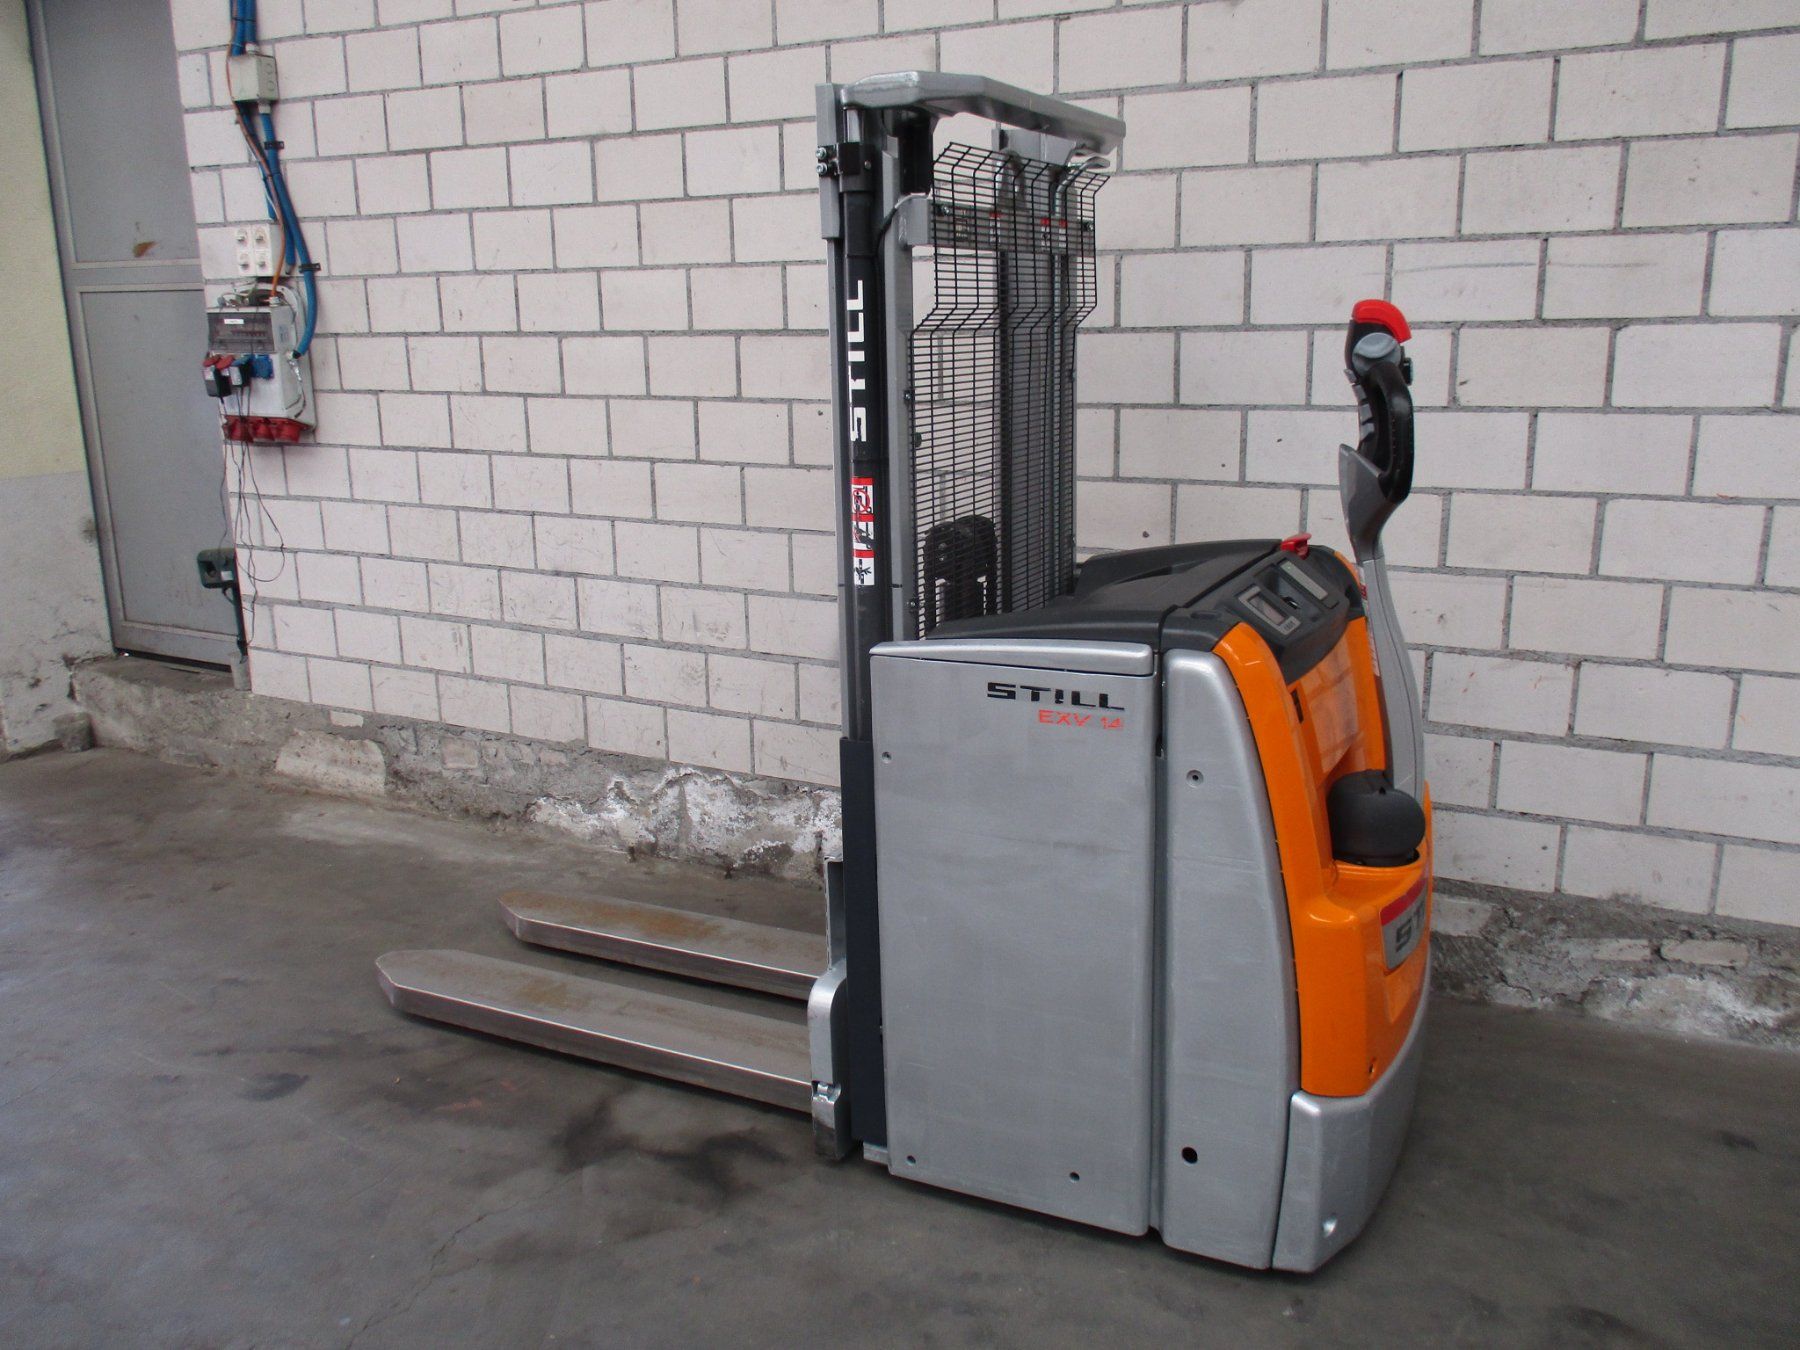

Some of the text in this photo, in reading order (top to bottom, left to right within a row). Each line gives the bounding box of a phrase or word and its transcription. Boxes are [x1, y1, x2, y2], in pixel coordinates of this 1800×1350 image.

[847, 279, 867, 442] STILL
[987, 682, 1125, 711] STILL
[1038, 709, 1122, 730] EXV 14
